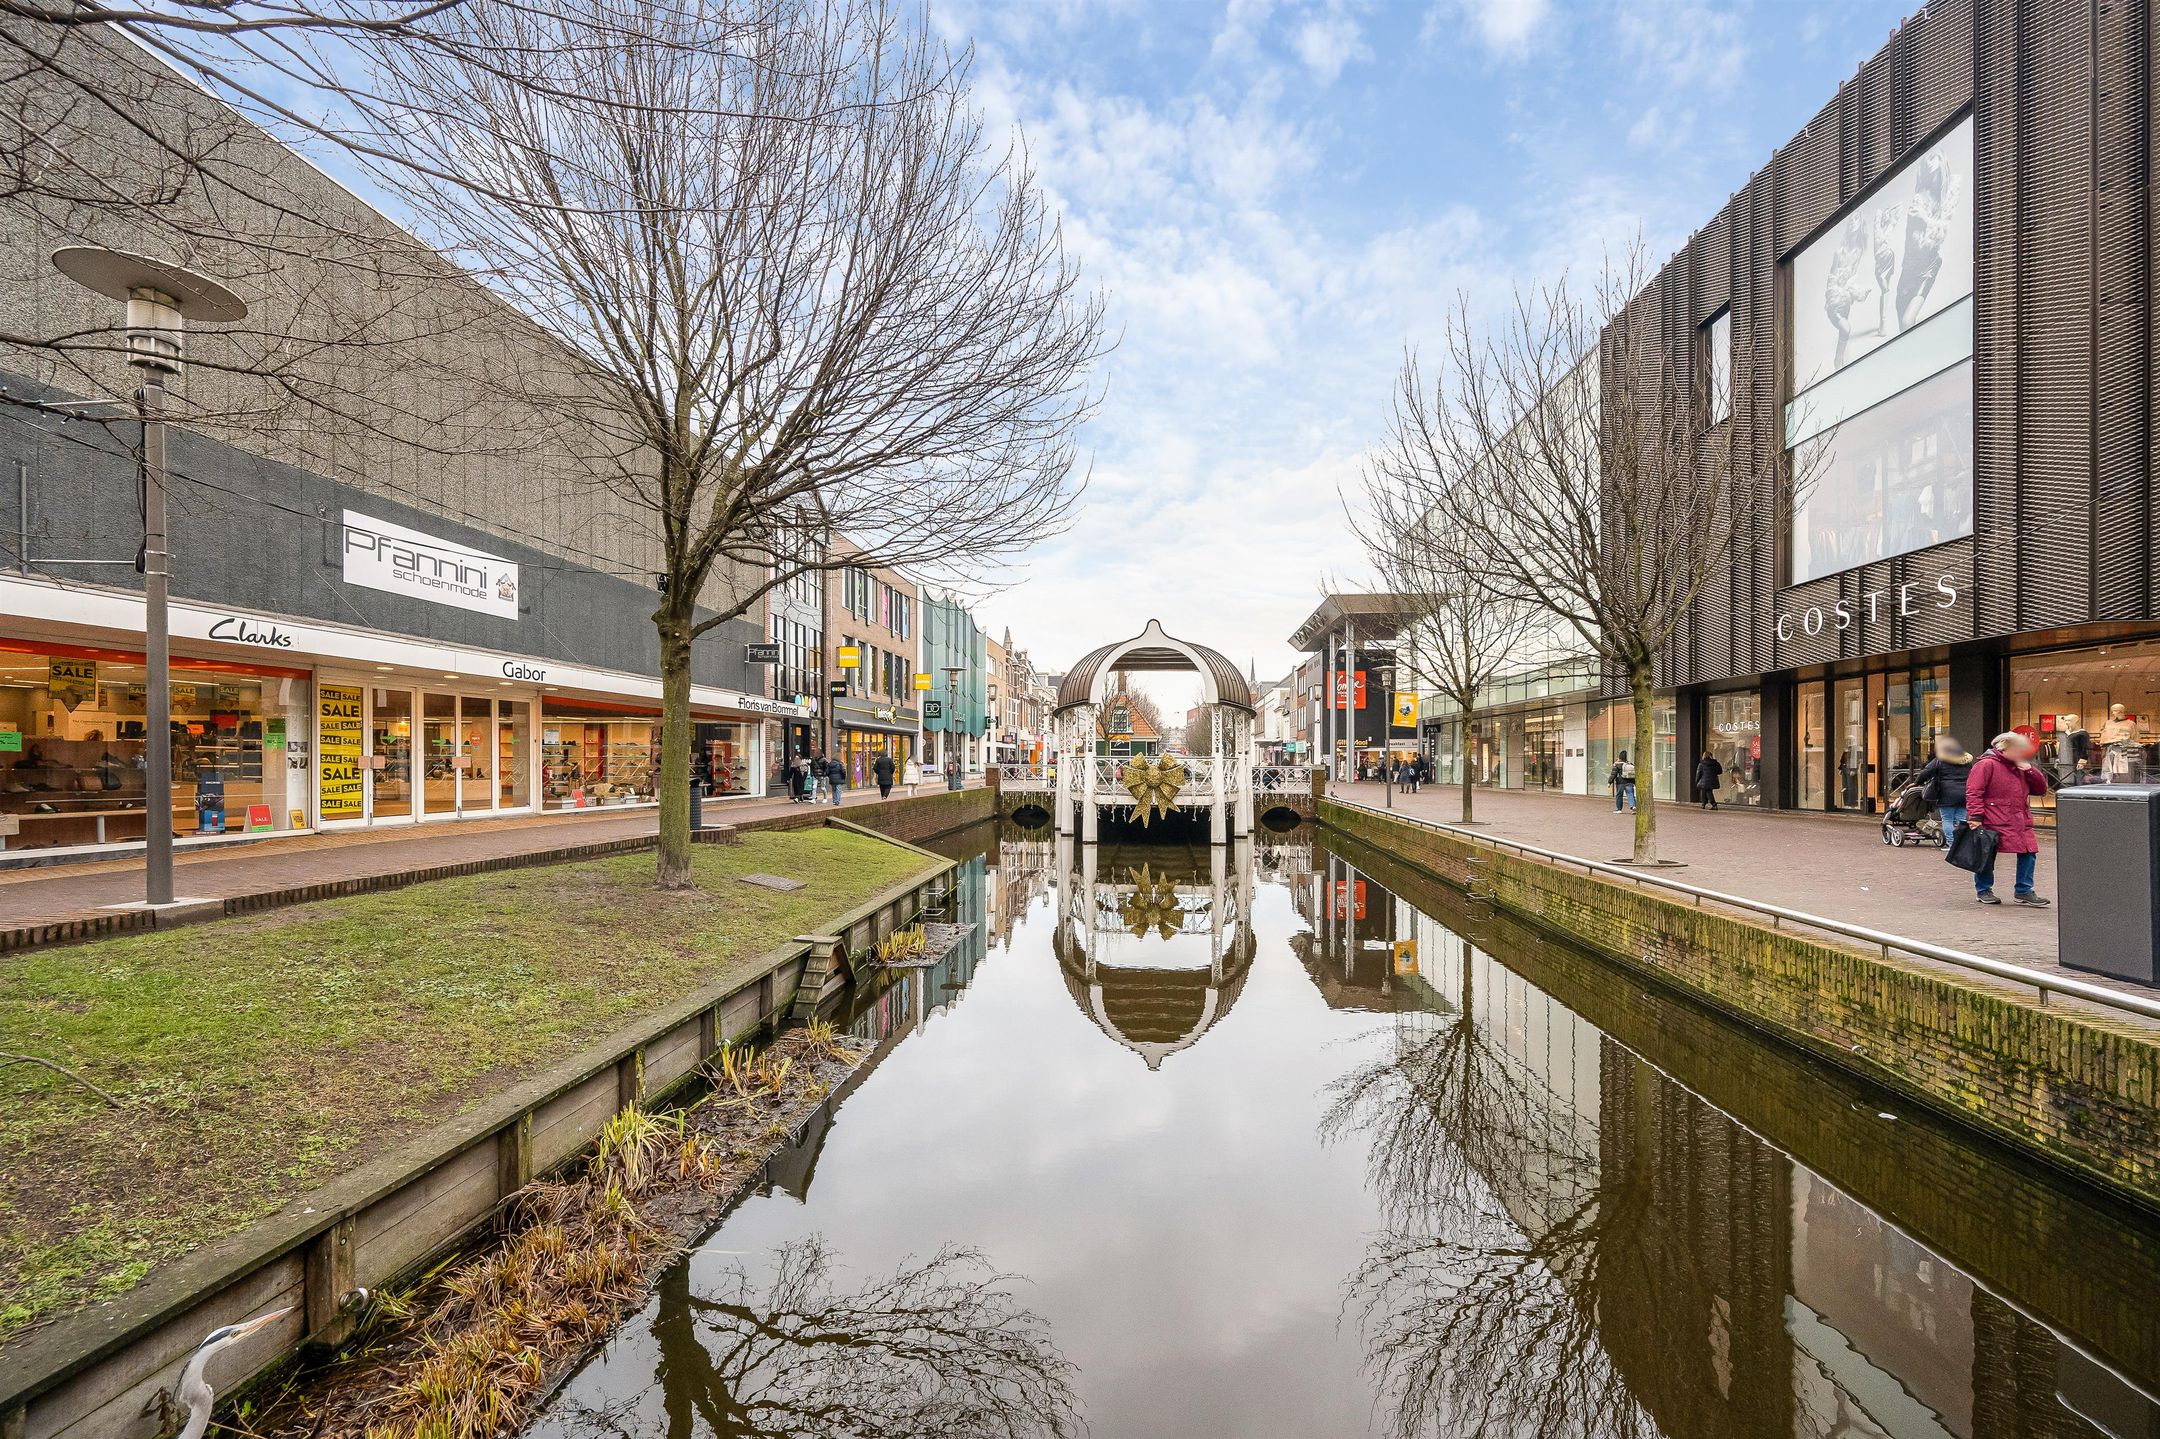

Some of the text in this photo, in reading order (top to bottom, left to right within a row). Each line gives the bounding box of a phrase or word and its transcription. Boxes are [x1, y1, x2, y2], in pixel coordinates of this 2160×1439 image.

[393, 569, 487, 600] schoenmode
[1777, 575, 1957, 641] COSTES
[208, 618, 291, 647] Clarks
[52, 665, 94, 679] SALE
[502, 661, 546, 682] Gabor
[320, 690, 340, 699] SALE
[321, 703, 360, 717] SALE
[738, 697, 798, 716] Floris van Bommel
[320, 722, 362, 730] SALE SALE
[1719, 721, 1760, 731] COSTES
[320, 736, 340, 744] SALE
[321, 755, 340, 763] SALE
[322, 767, 360, 780] SALE
[321, 784, 362, 794] SALE SALE
[321, 800, 362, 808] SALE SALE
